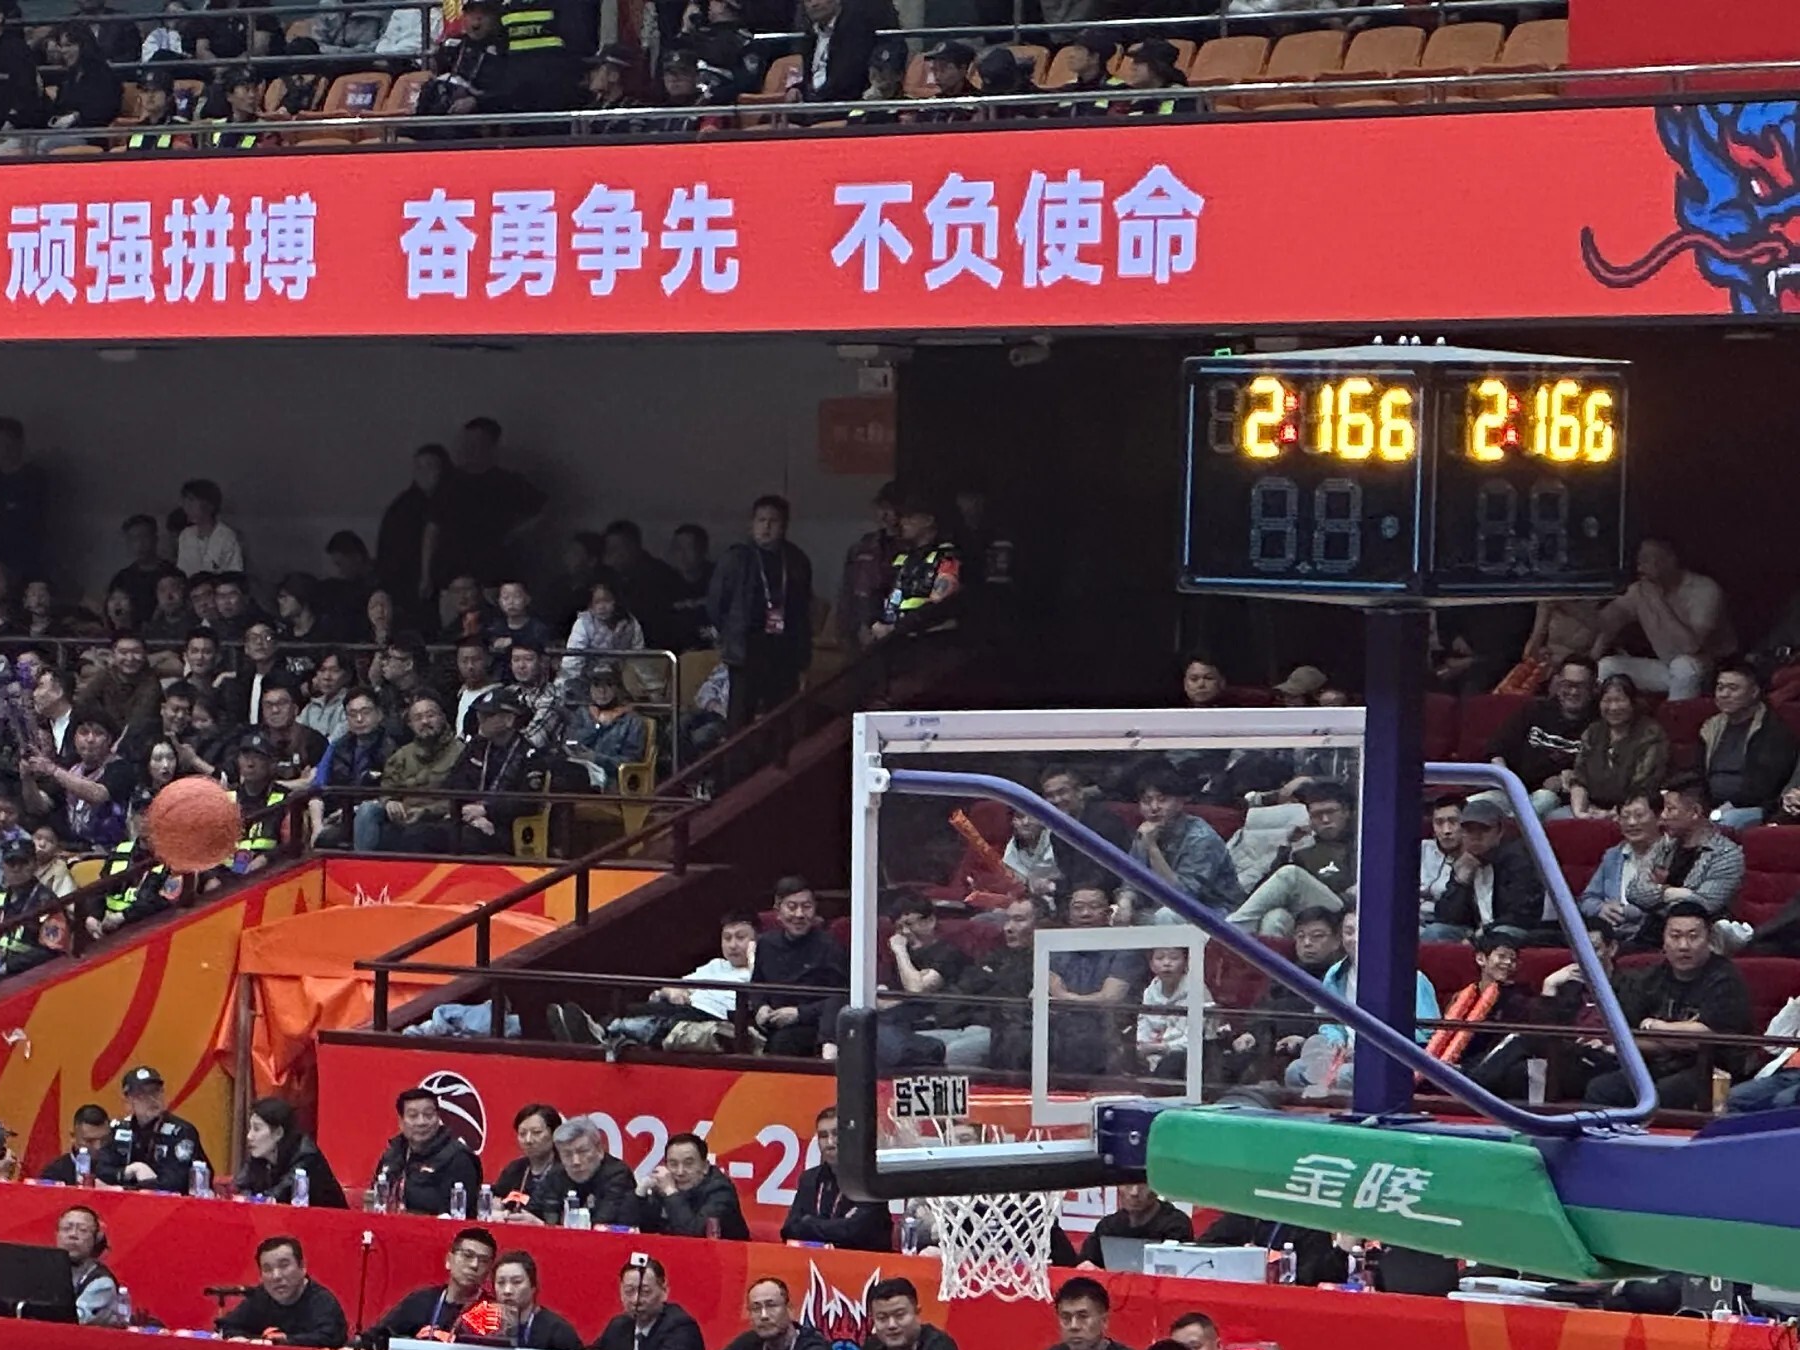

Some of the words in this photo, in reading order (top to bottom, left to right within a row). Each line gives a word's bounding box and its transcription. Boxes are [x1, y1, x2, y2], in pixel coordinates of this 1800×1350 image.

[4, 193, 318, 305] 顽强拼搏
[400, 182, 740, 299] 奋勇争先
[831, 163, 1204, 292] 不负使命
[1254, 1154, 1463, 1226] 金陵
